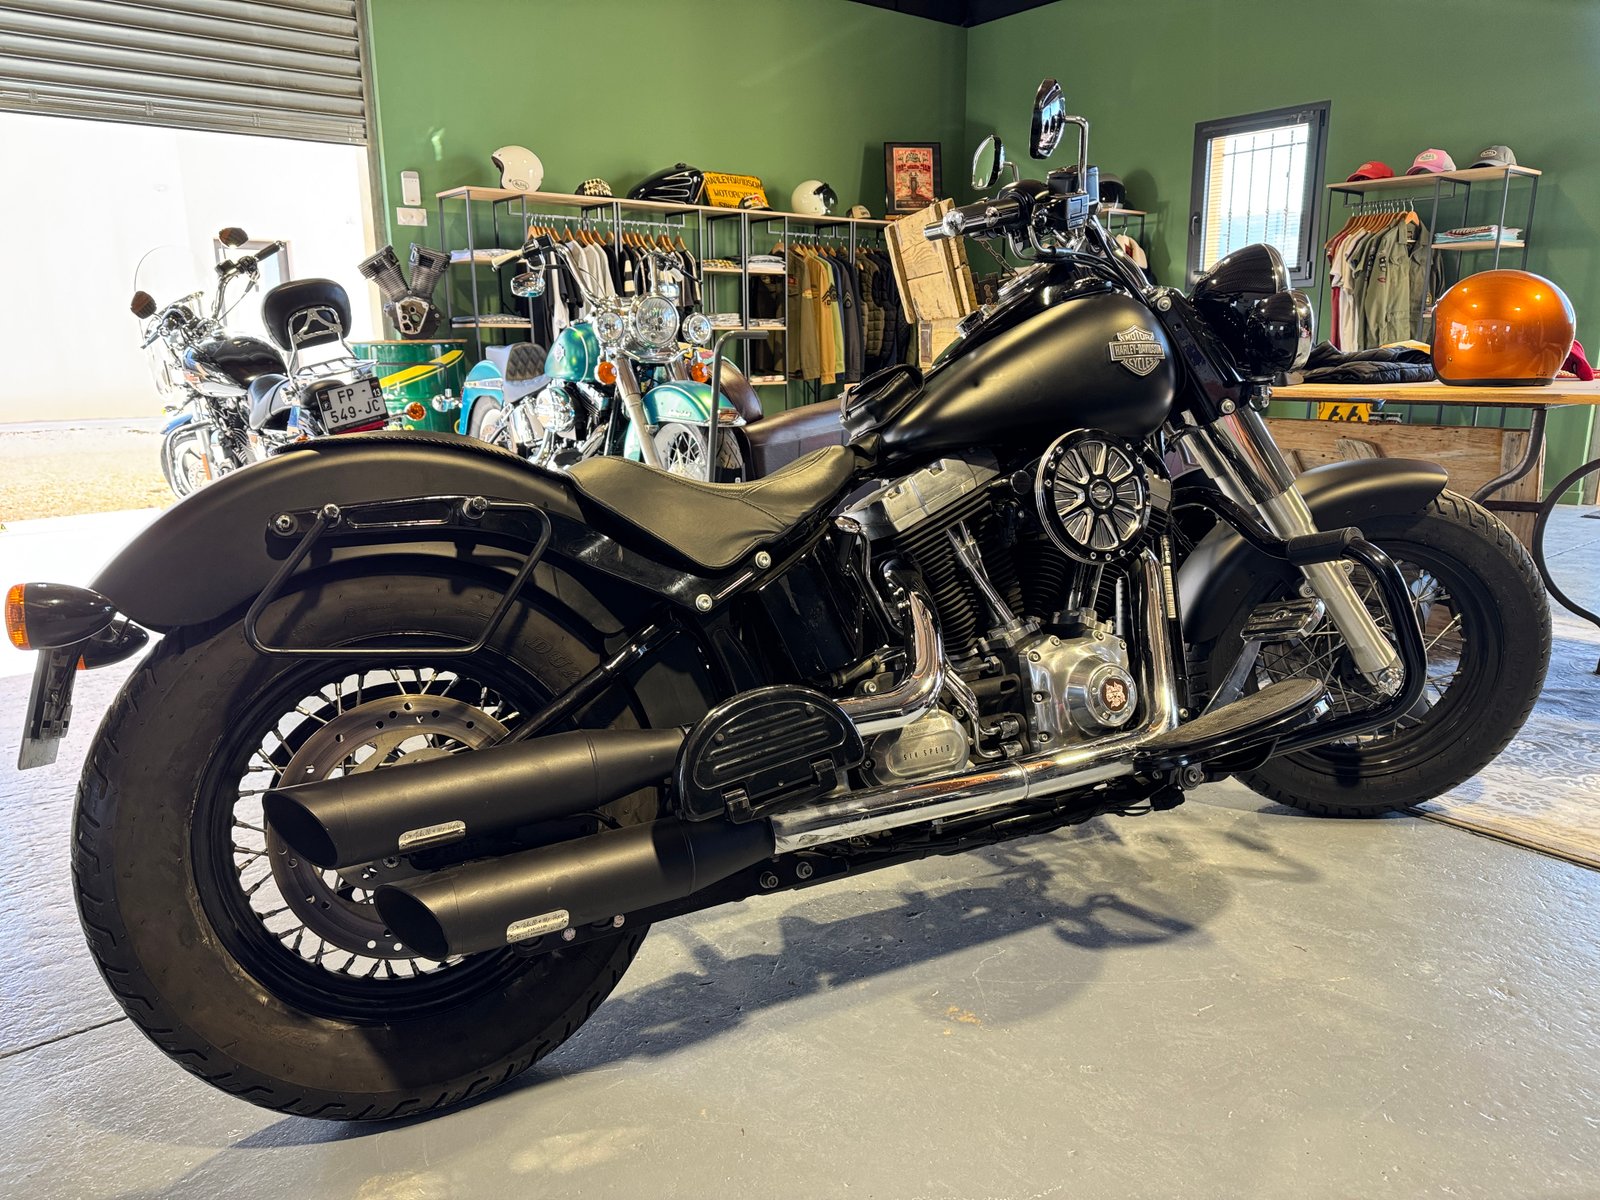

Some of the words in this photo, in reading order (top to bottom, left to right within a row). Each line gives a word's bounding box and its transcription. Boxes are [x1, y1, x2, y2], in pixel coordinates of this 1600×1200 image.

[1124, 330, 1151, 341] MOTOR
[1114, 343, 1163, 356] HARLEY-DAVIDSON
[1128, 358, 1155, 371] CYCLES
[372, 387, 382, 398] 13
[329, 399, 381, 424] 549-JC
[923, 744, 951, 757] SPEED
